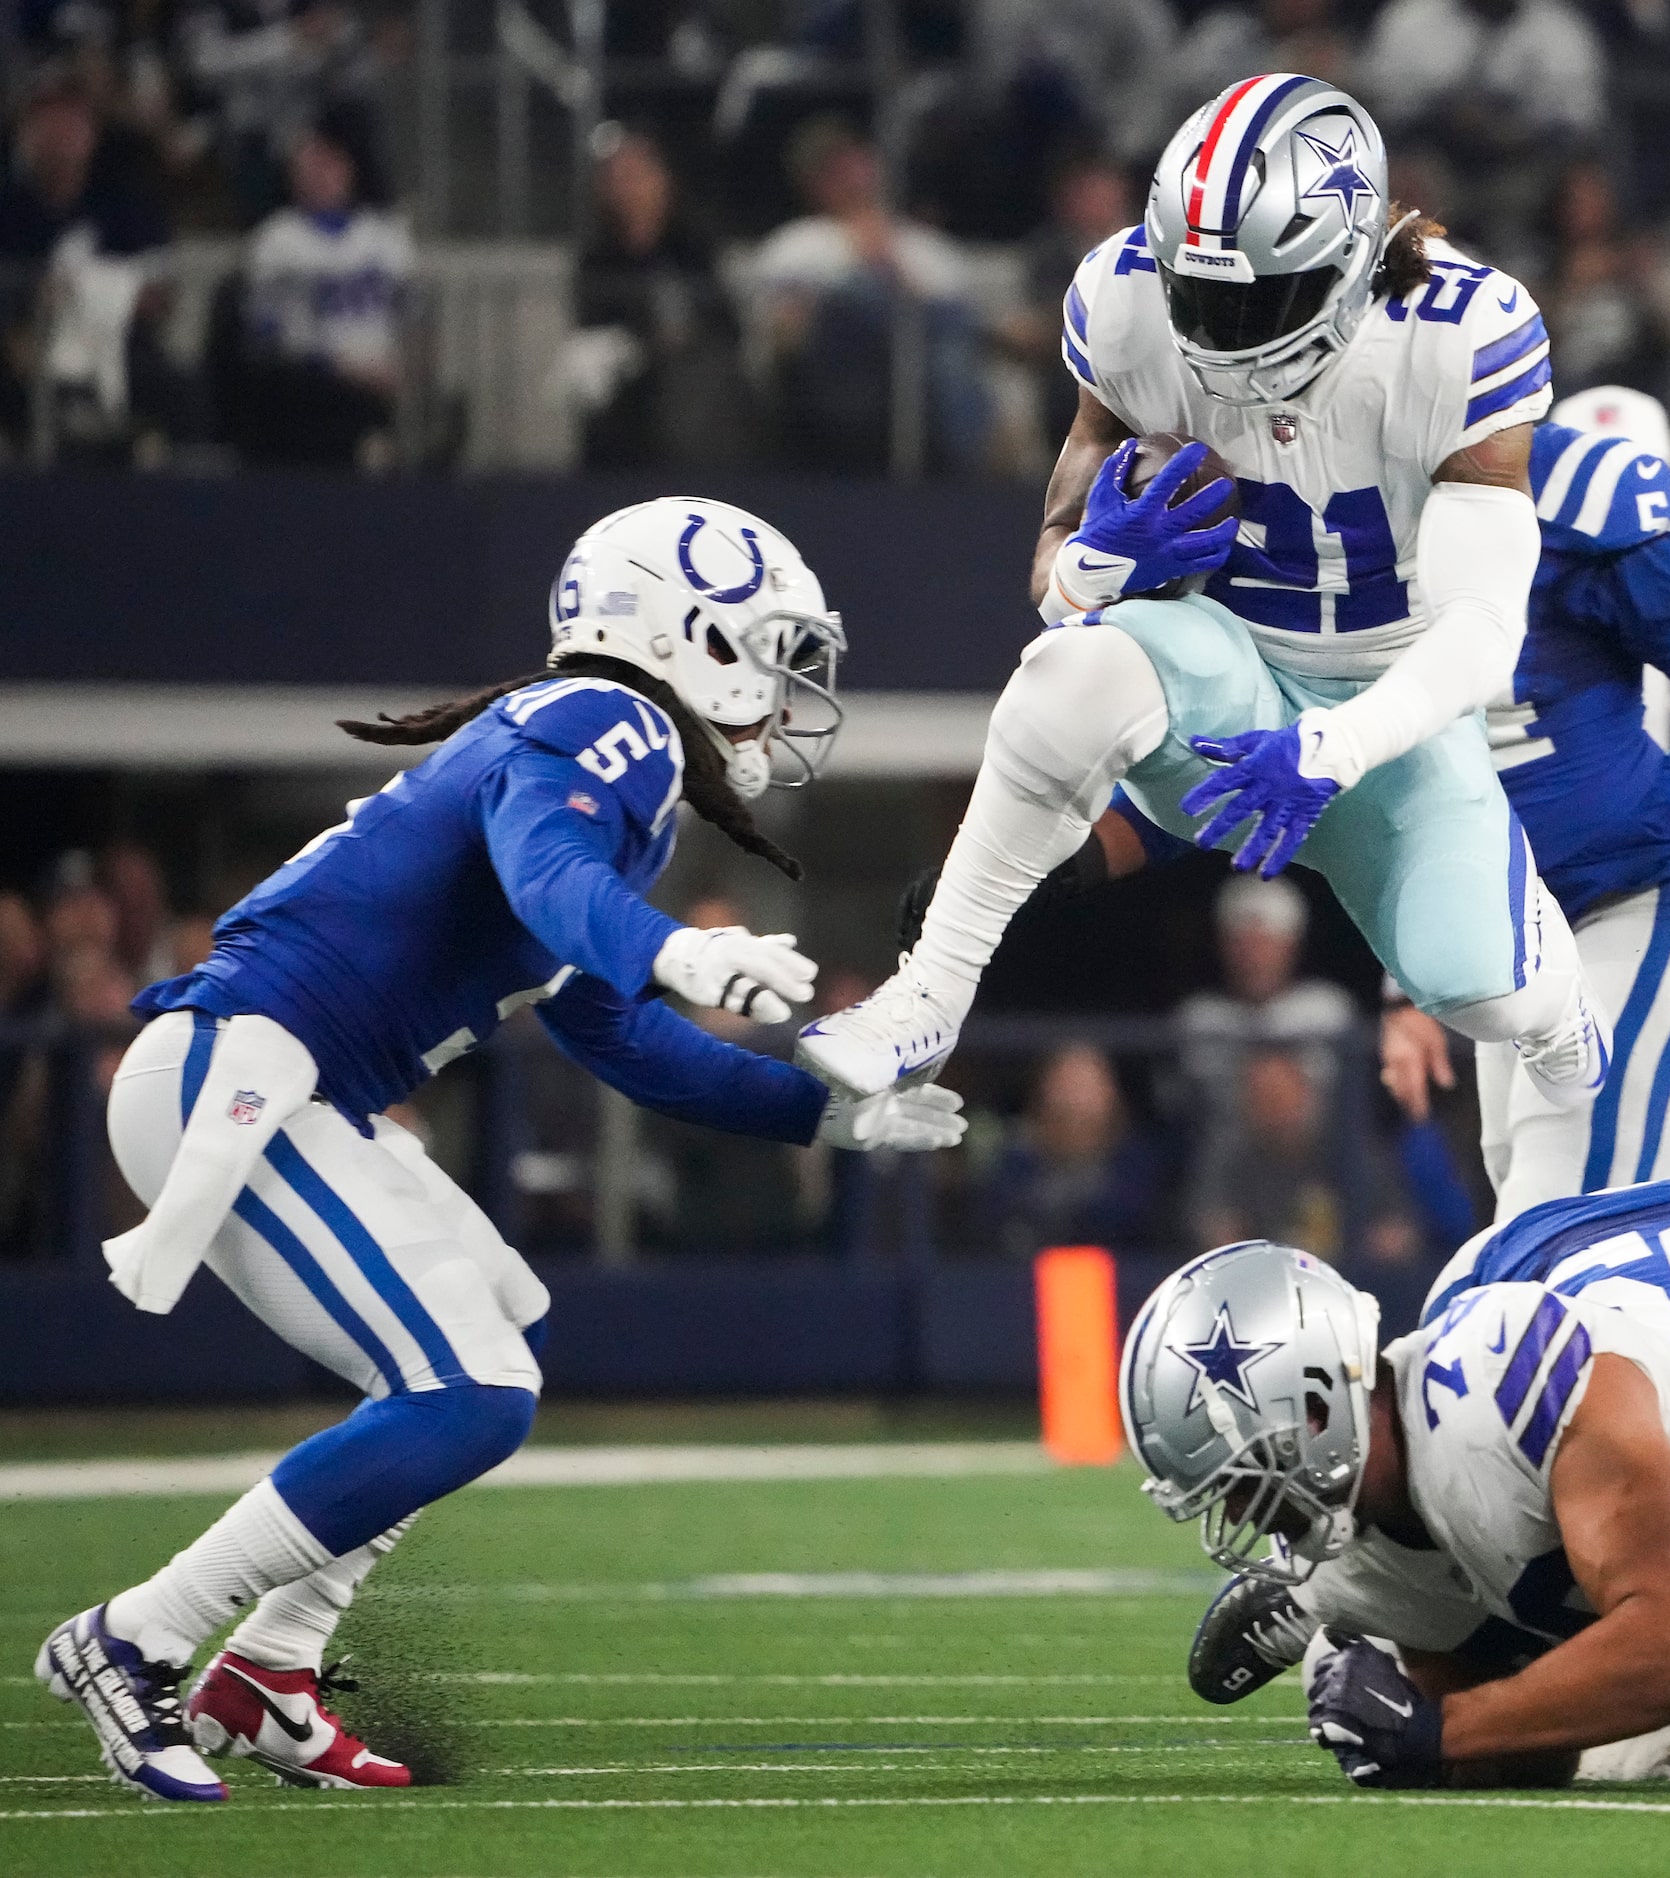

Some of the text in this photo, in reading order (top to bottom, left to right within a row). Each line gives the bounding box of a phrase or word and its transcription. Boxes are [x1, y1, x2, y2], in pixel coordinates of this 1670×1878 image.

[1184, 252, 1236, 267] COWBOYS
[1205, 477, 1412, 634] 21
[574, 720, 651, 784] 5
[94, 1667, 150, 1734] GILMORE
